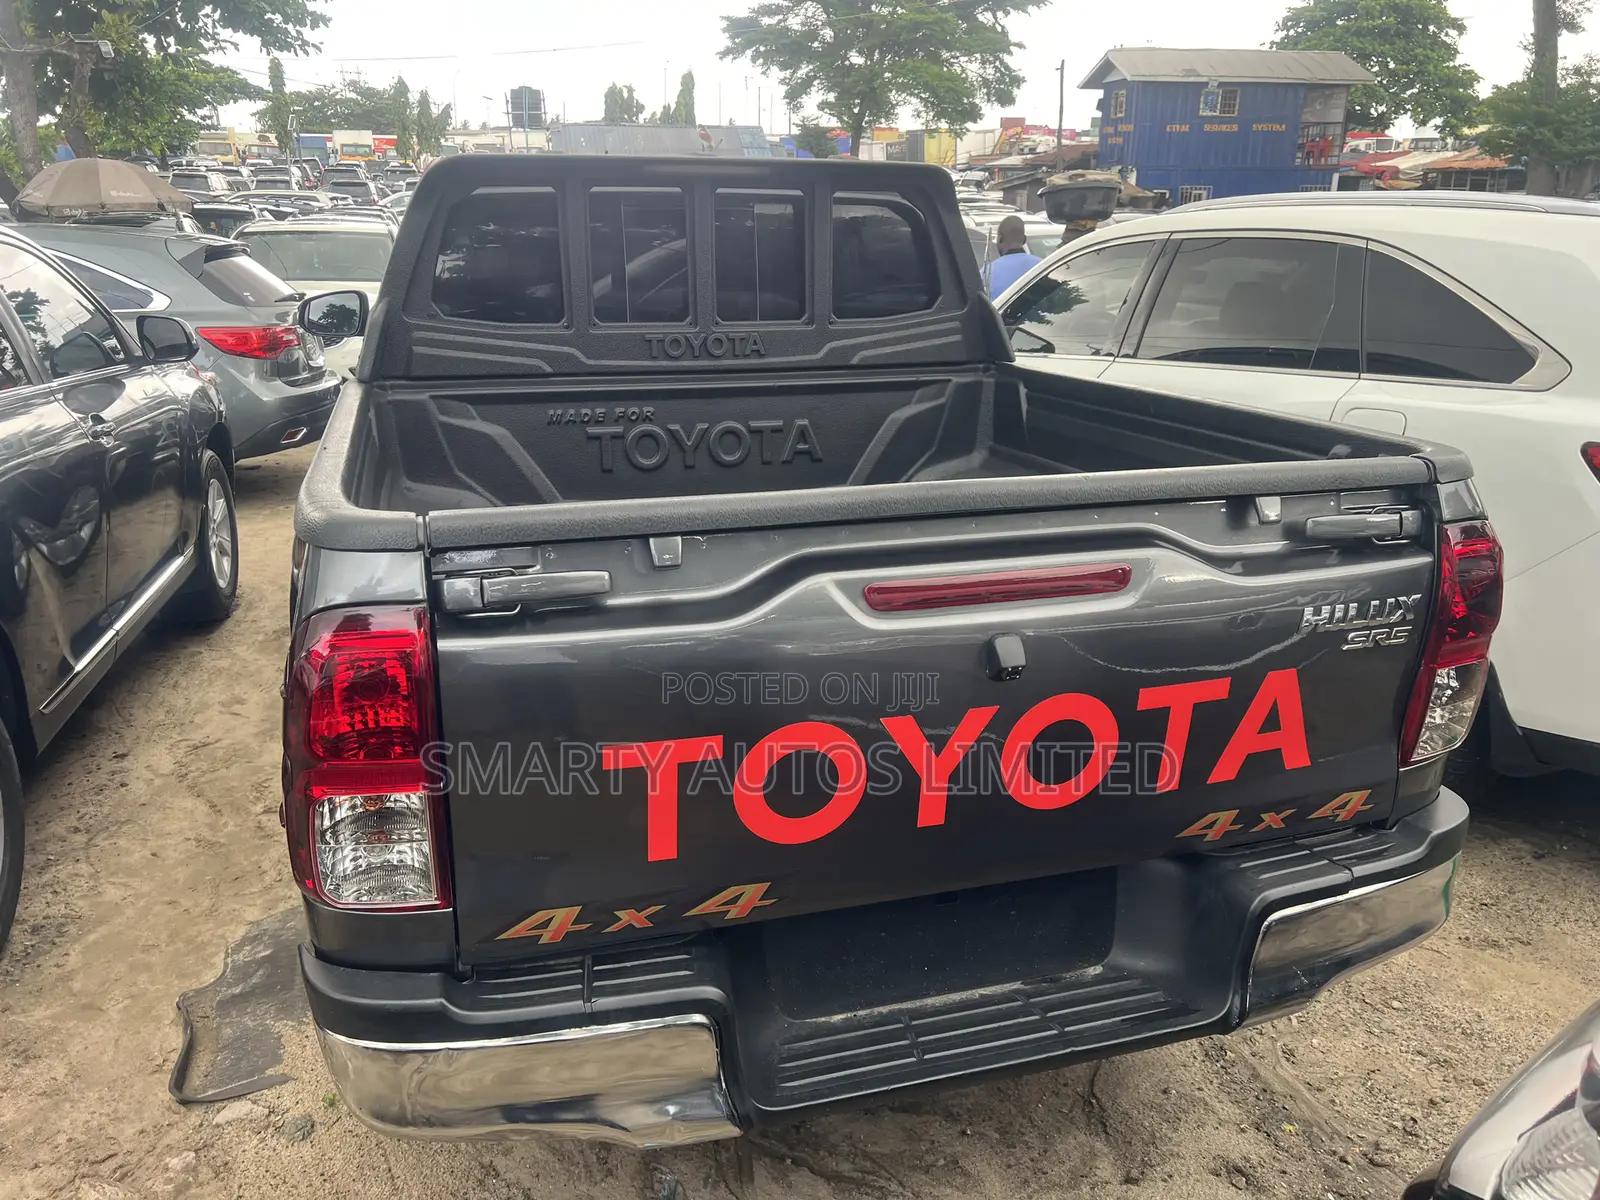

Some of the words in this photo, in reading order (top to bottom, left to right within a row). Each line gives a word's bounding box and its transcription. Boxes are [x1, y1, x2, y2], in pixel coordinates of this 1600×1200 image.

[644, 332, 767, 358] TOYOTA
[547, 408, 606, 424] MADE
[614, 406, 655, 422] FOR
[585, 418, 823, 473] TOYOTA
[1301, 594, 1422, 630] HILUX
[1341, 625, 1413, 651] SR5
[603, 669, 1310, 861] TOYOTA
